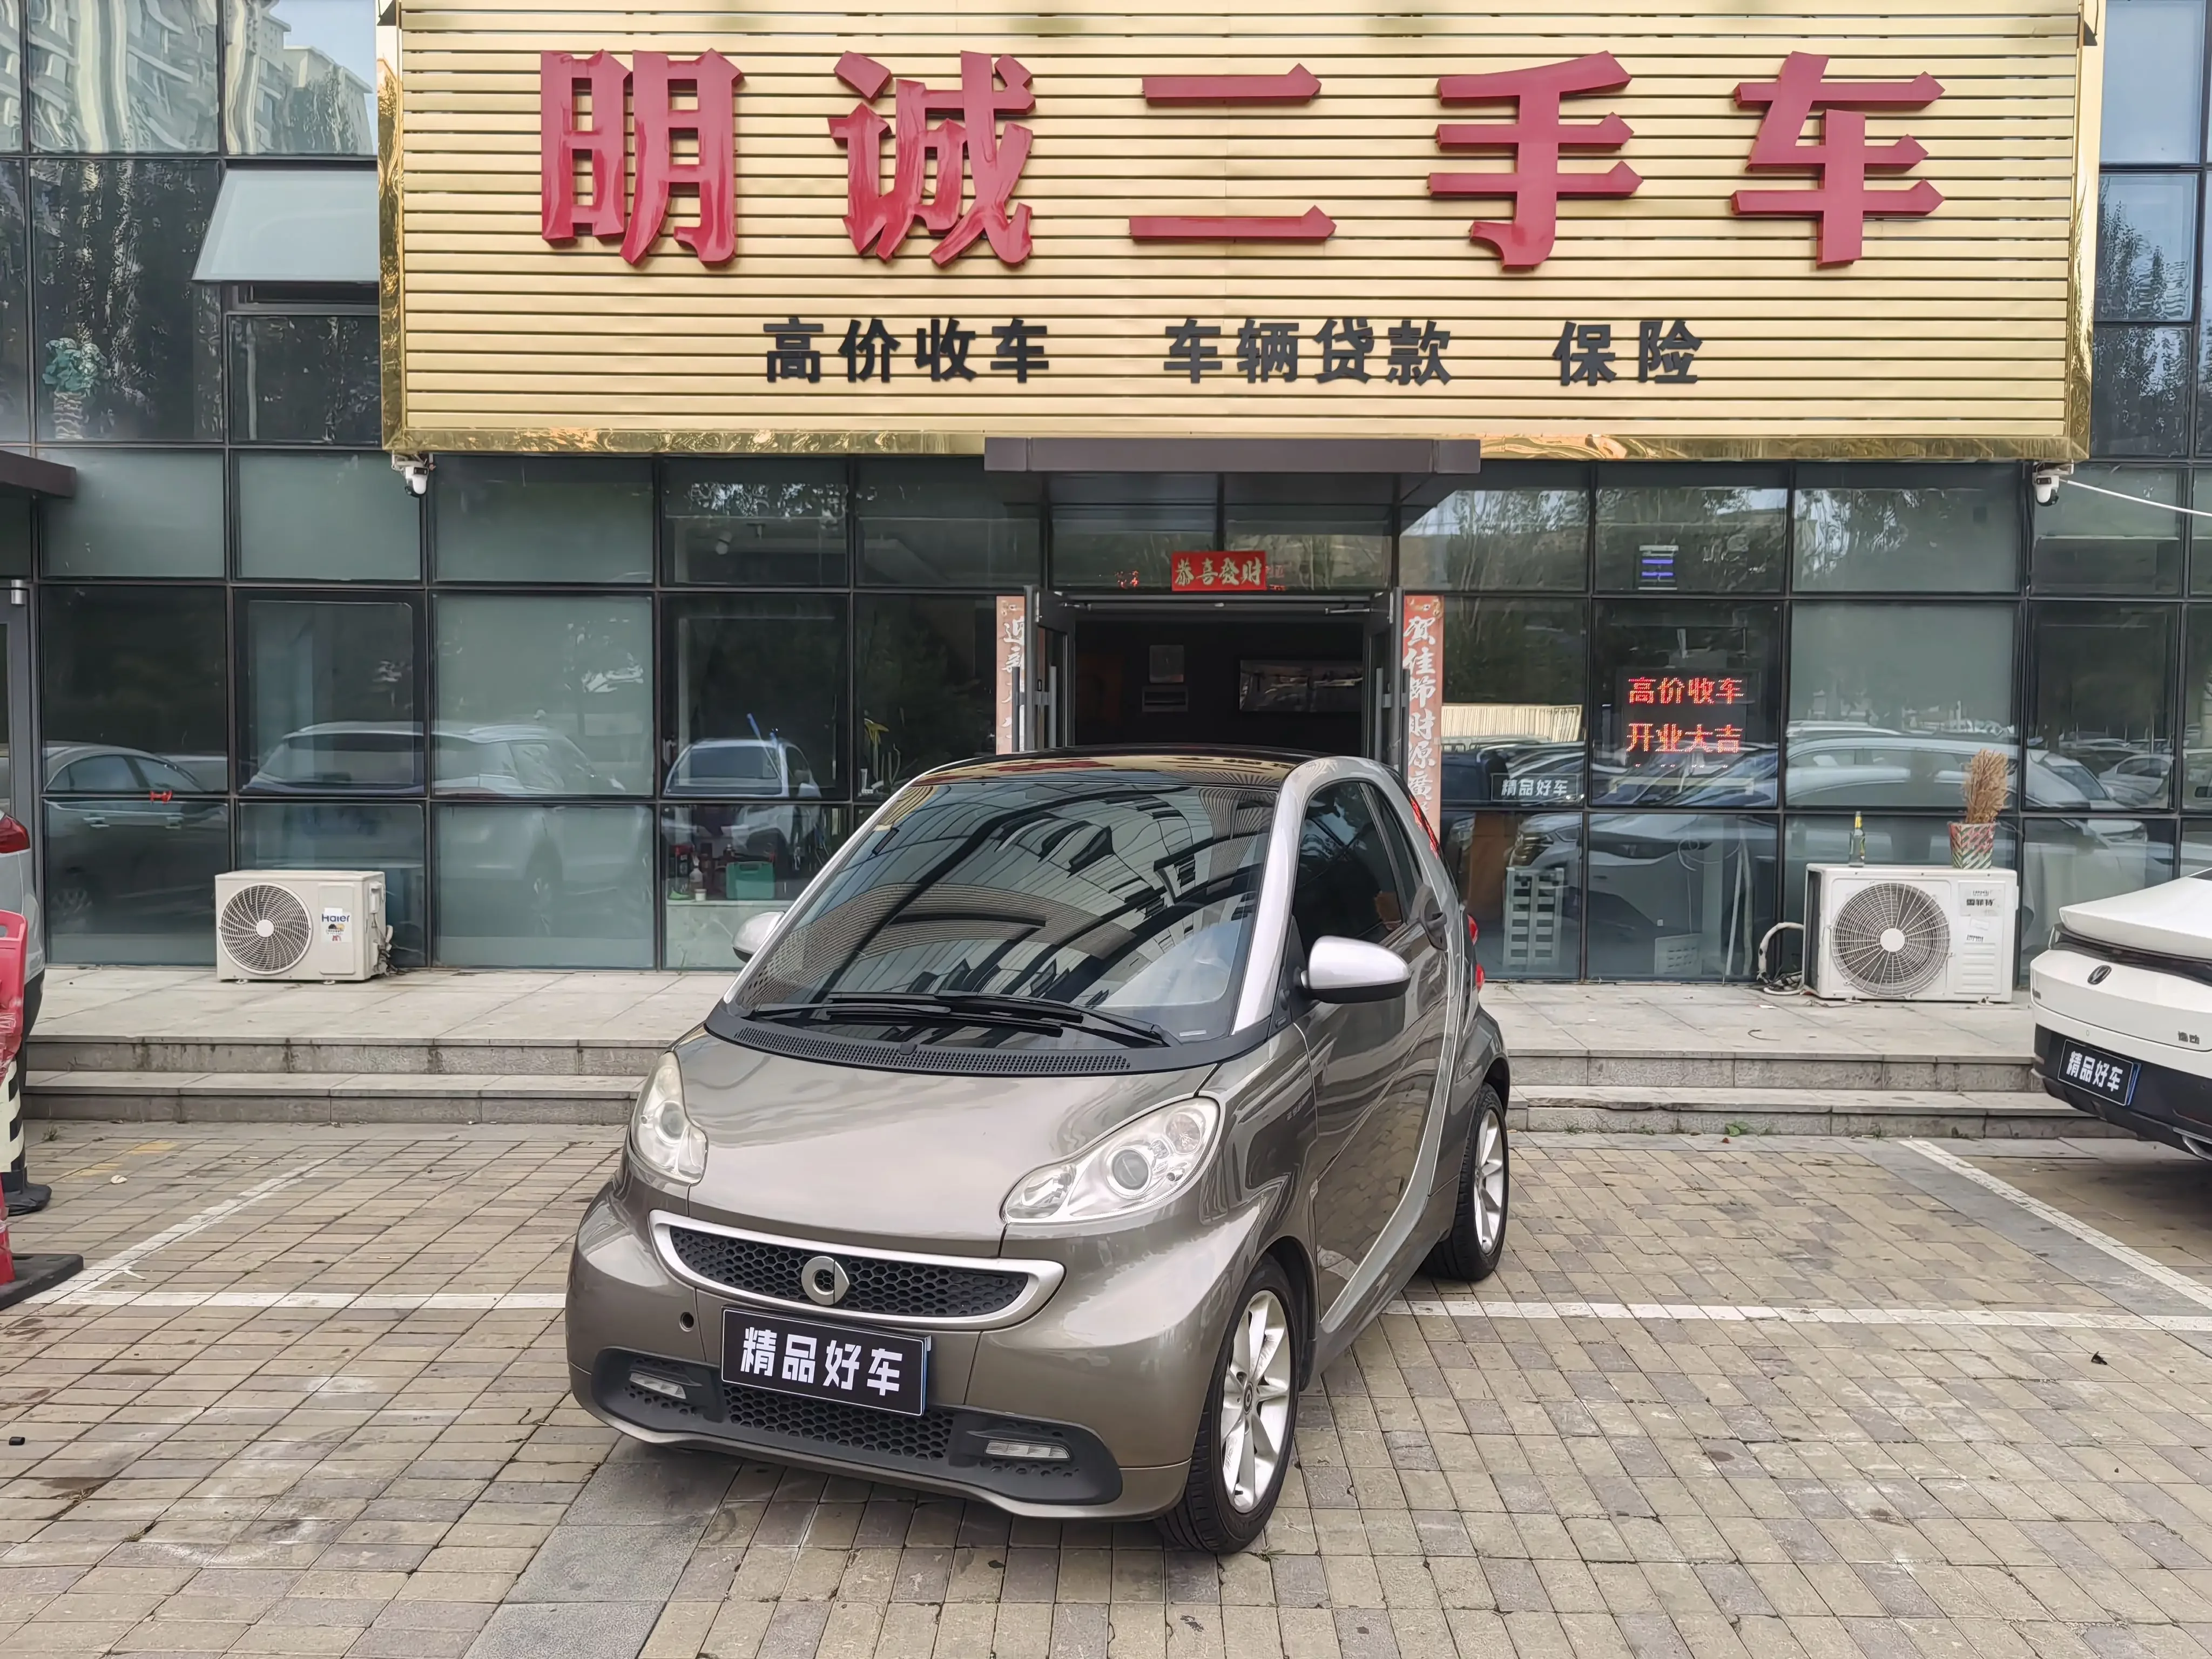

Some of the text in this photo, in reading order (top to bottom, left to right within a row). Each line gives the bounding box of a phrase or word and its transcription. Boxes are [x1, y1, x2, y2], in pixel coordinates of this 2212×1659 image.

[541, 49, 1946, 272] 明诚二手车
[763, 316, 1704, 386] 高价收车 车辆贷款 保险
[1628, 677, 1745, 705] 高价收车
[1626, 723, 1744, 753] 开业大吉
[1501, 778, 1569, 797] 精品好车
[321, 913, 350, 922] Haier
[2066, 1050, 2123, 1092] 精品好车
[739, 1326, 903, 1397] 精品好车
